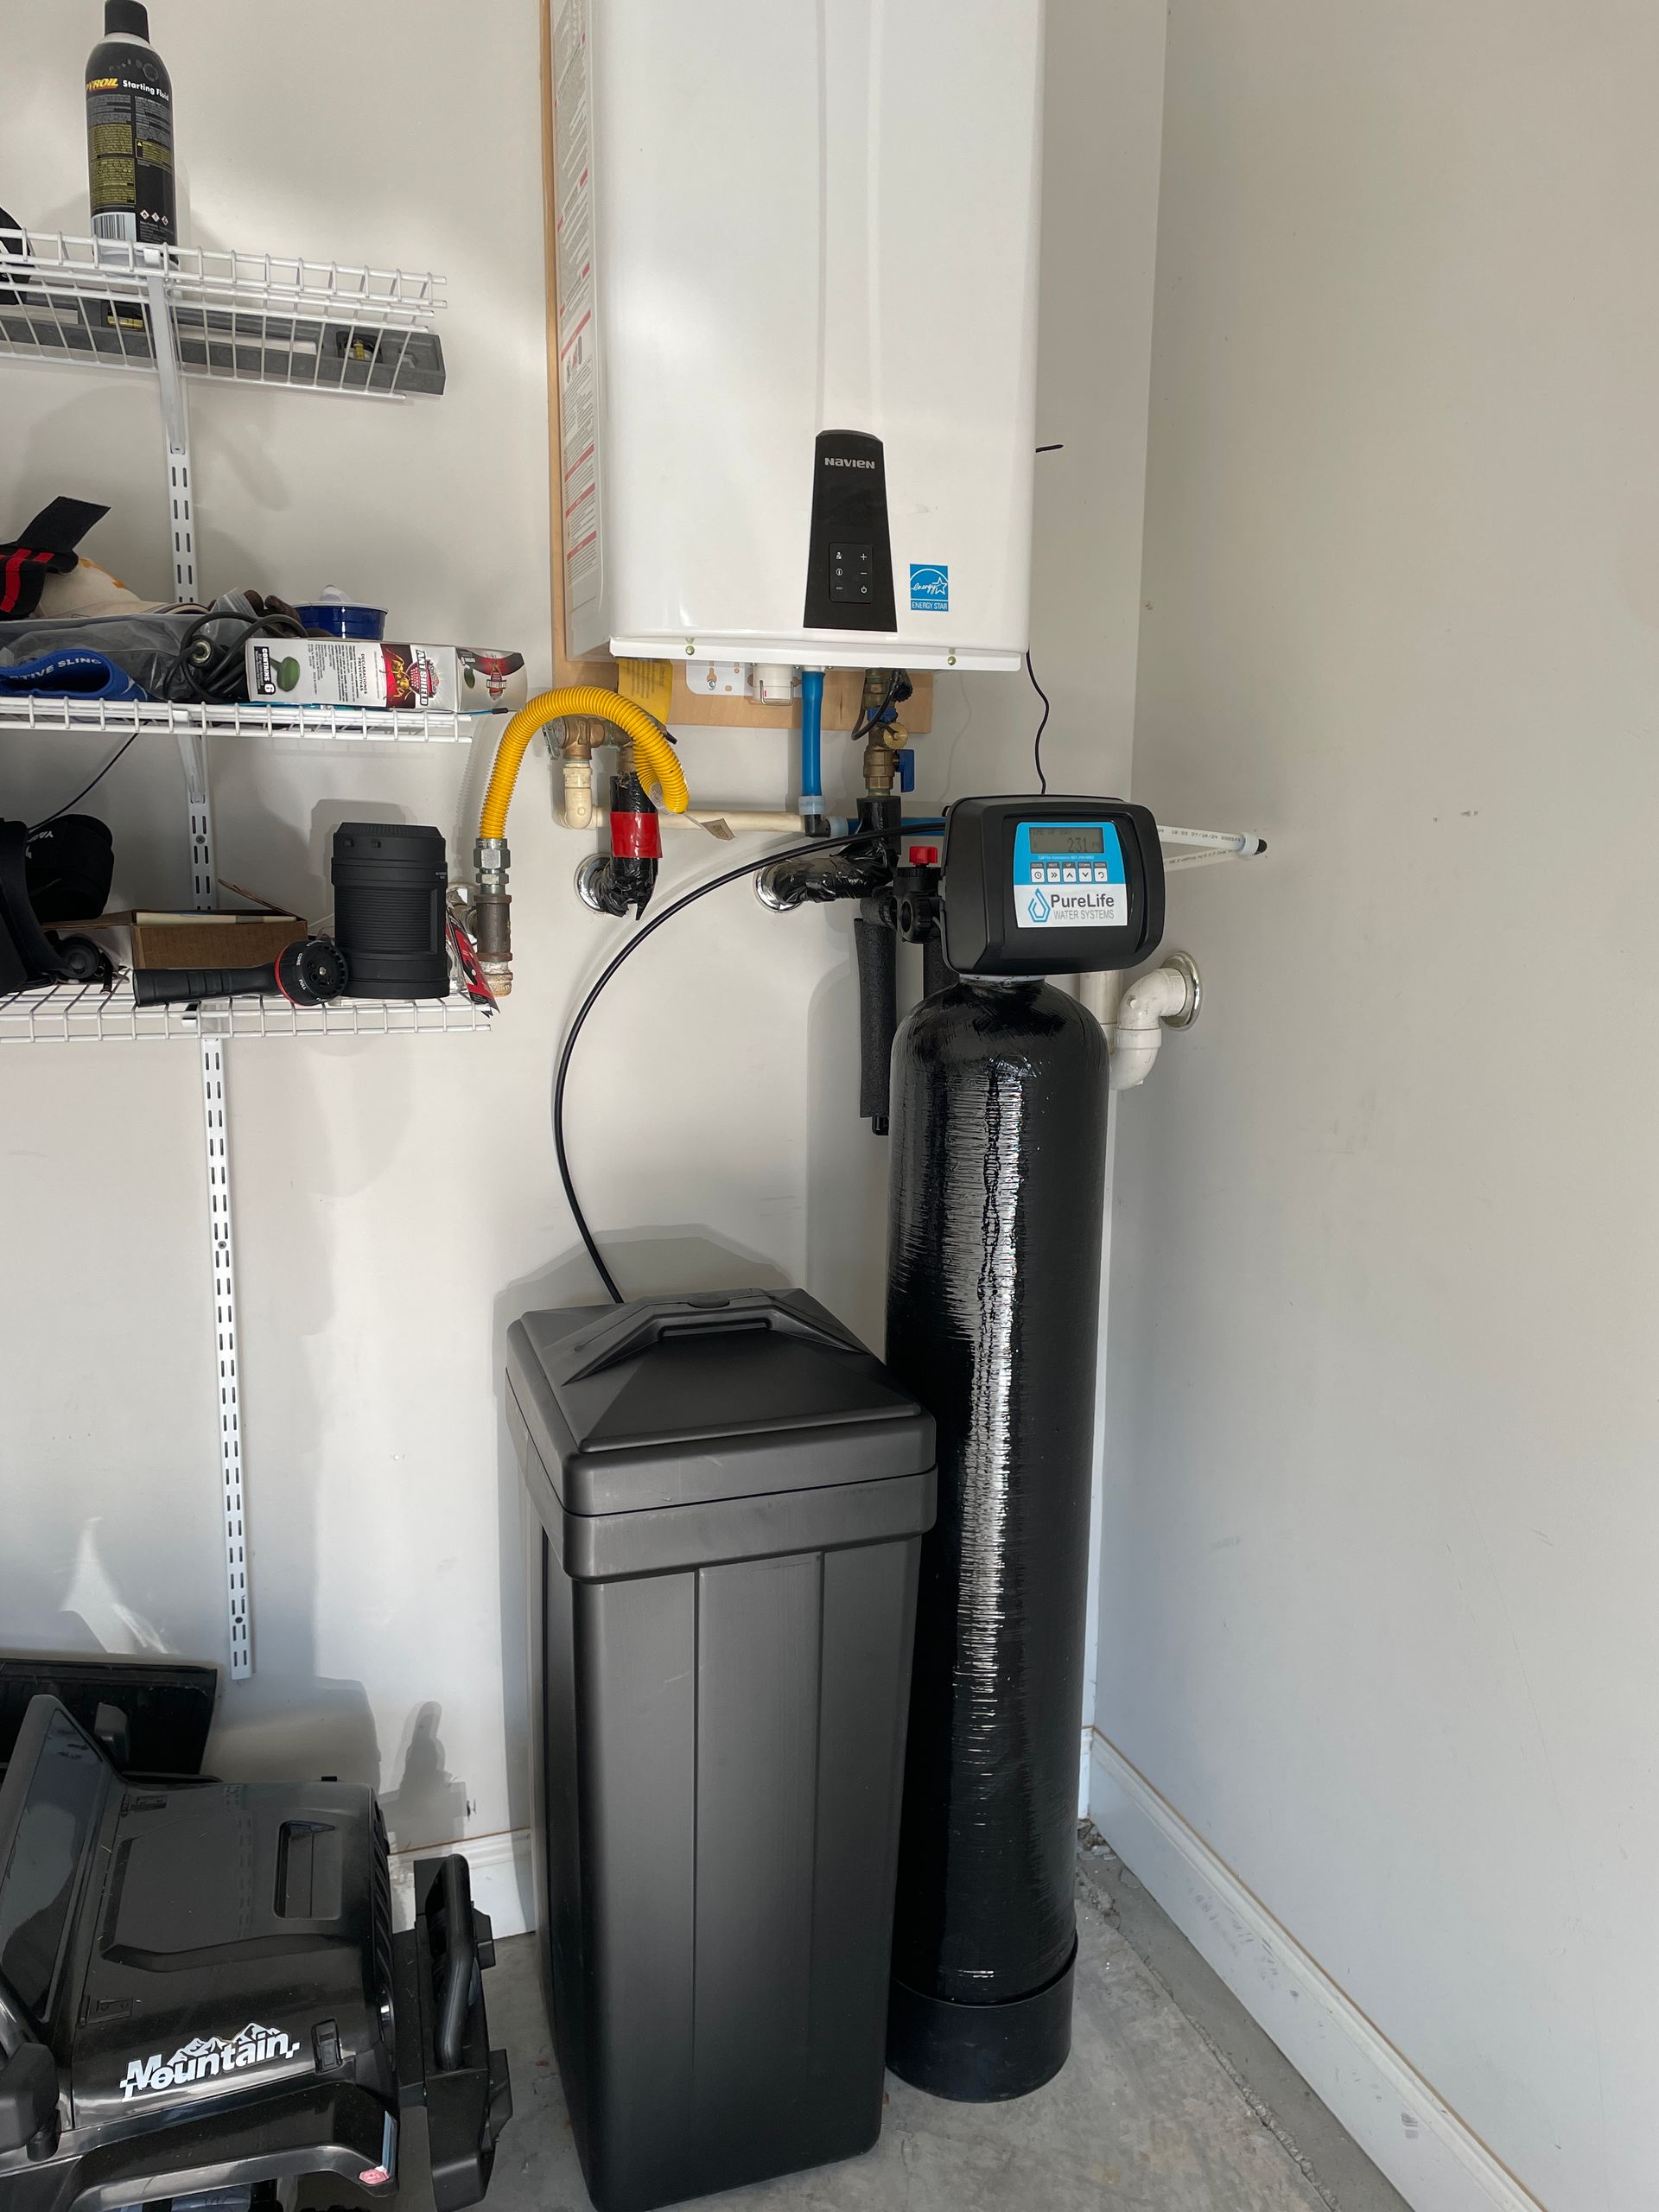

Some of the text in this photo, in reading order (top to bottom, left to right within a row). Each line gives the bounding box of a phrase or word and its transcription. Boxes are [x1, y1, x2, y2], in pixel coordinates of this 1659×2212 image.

[123, 79, 169, 101] Starting Fluid
[262, 648, 275, 693] CONTAINS 6
[416, 650, 429, 705] ANT SHIELD
[1051, 893, 1115, 908] PureLife
[1053, 909, 1115, 919] WATER SYSTEMS
[120, 2032, 301, 2102] Mountain
